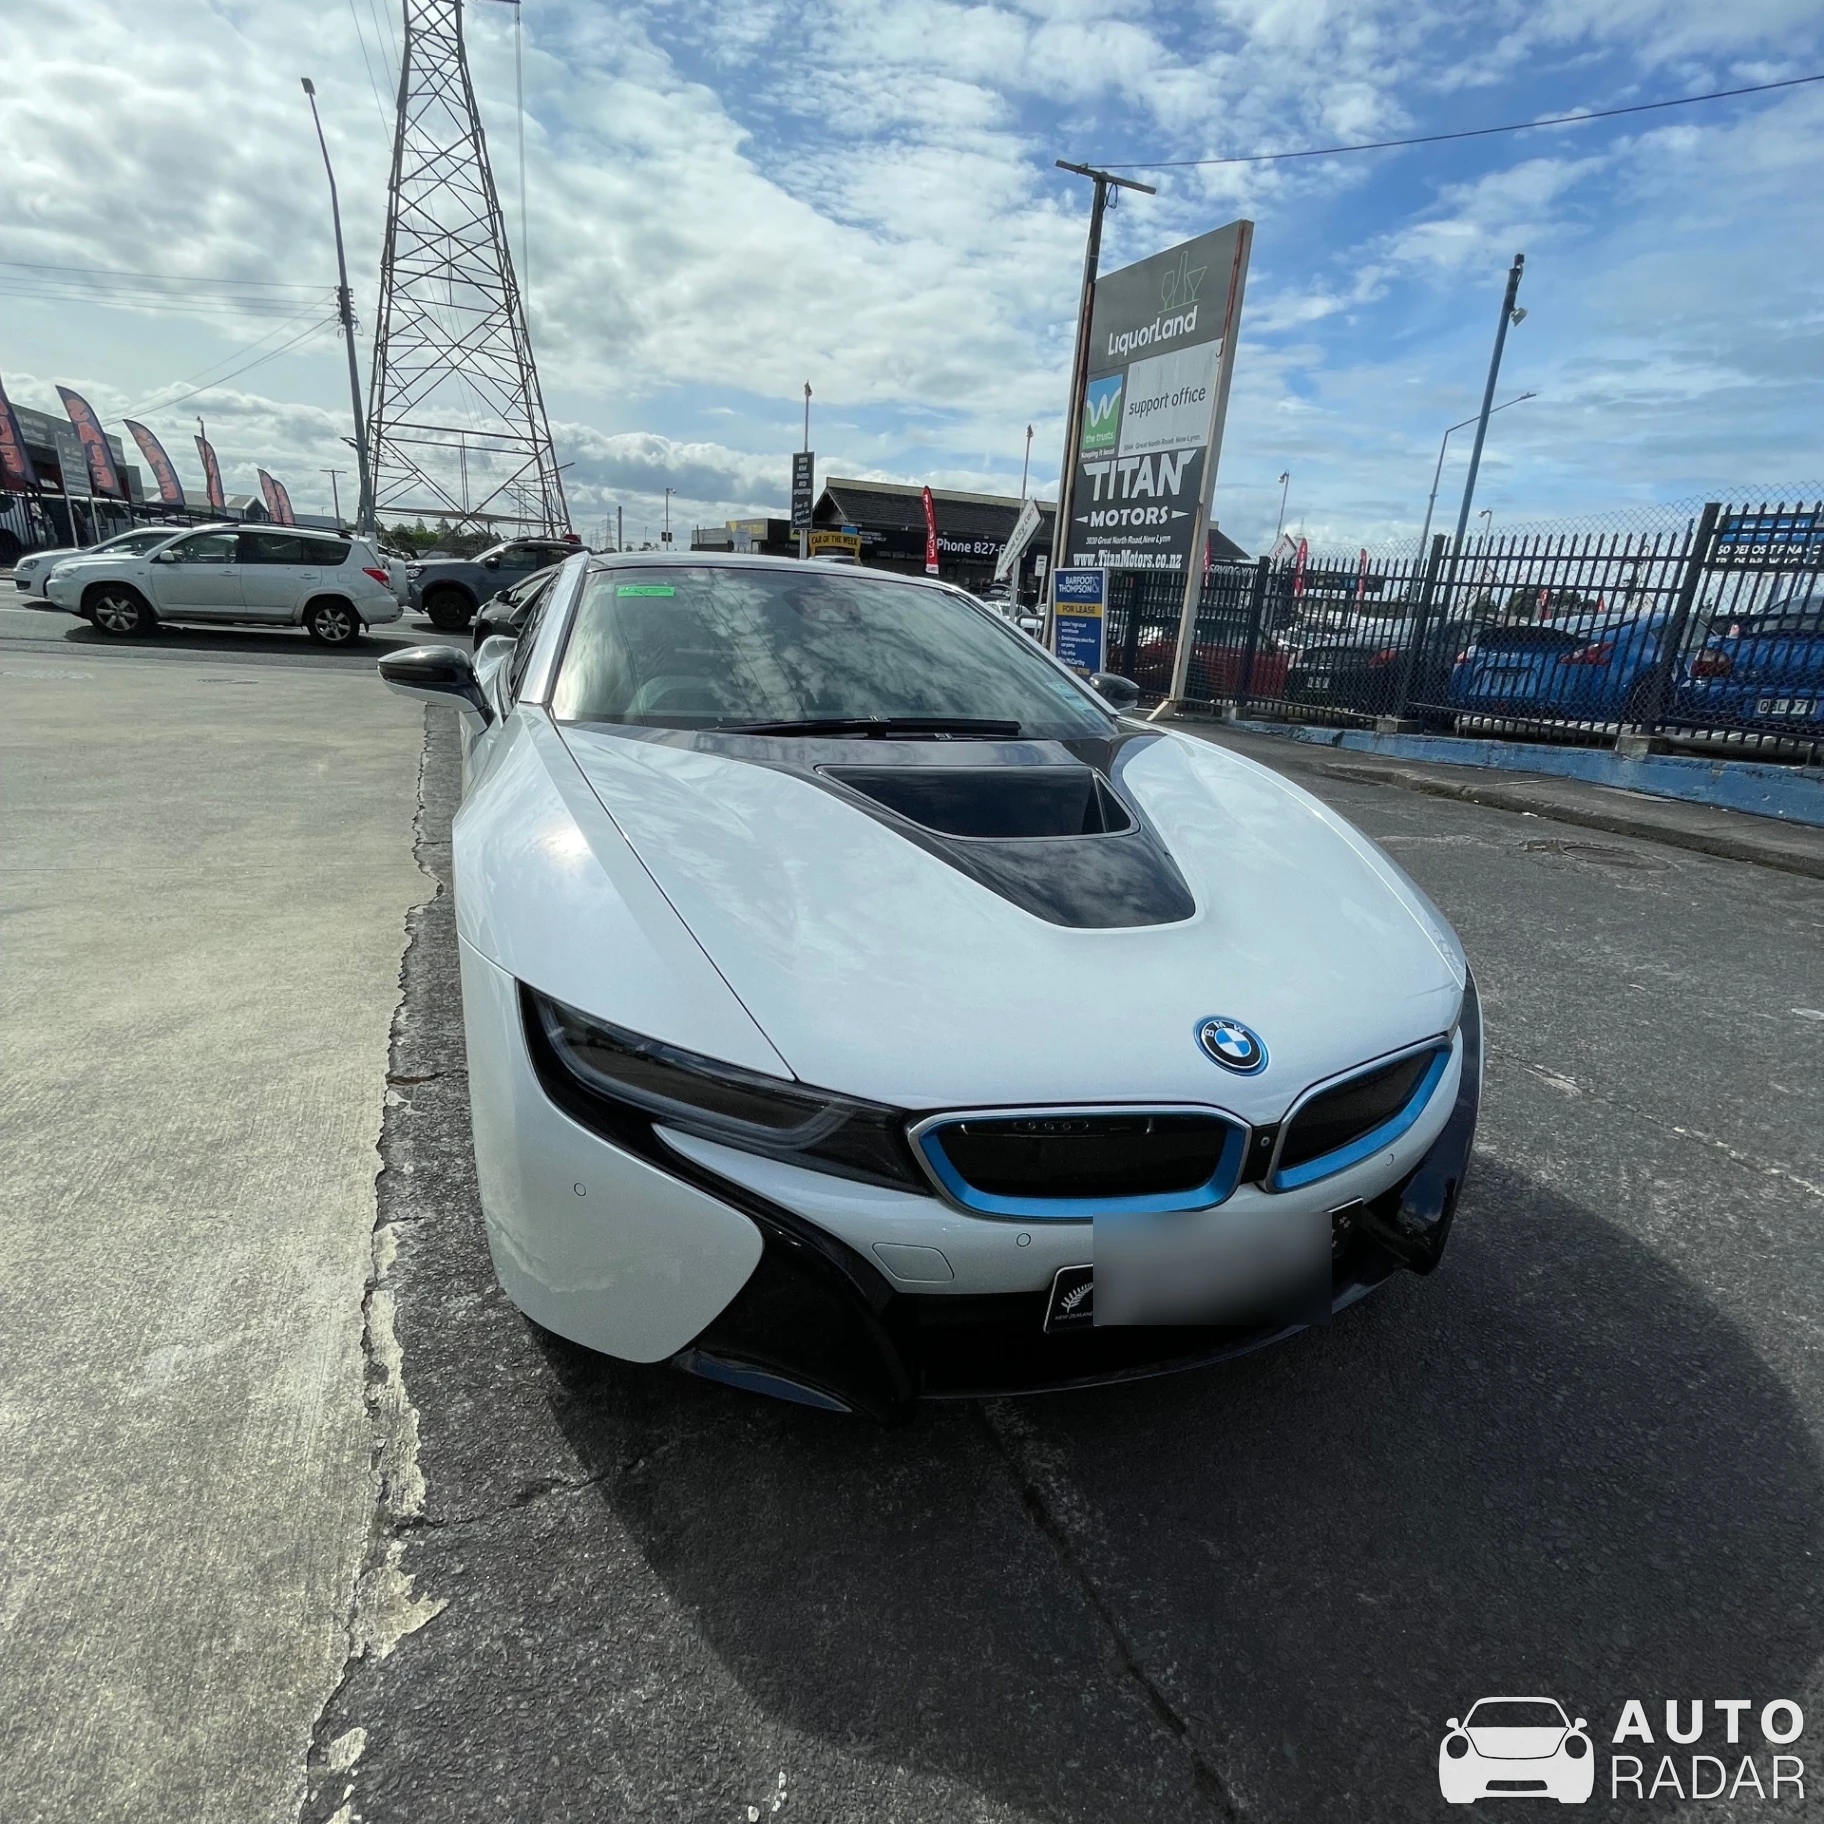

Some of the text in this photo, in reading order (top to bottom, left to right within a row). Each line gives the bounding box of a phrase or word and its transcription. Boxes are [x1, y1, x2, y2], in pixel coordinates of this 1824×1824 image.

[1107, 305, 1198, 356] LiquorLand
[1128, 386, 1206, 418] support office
[1096, 430, 1114, 442] trusts
[1083, 449, 1197, 501] TITAN
[1090, 506, 1168, 527] MOTORS
[811, 536, 822, 545] CAR
[823, 535, 830, 543] OF
[831, 535, 842, 543] THE
[843, 536, 858, 546] WEEK
[936, 538, 972, 553] Phone
[1098, 536, 1112, 545] Great
[1112, 536, 1127, 545] North
[1156, 534, 1172, 545] Lynn
[1073, 549, 1183, 569] www.TitanMotors.co.nz
[1065, 576, 1093, 585] BARFOOT
[1058, 584, 1092, 593] THOMPSON
[1062, 605, 1096, 614] FOR LEASE
[1204, 1021, 1245, 1038] BMW
